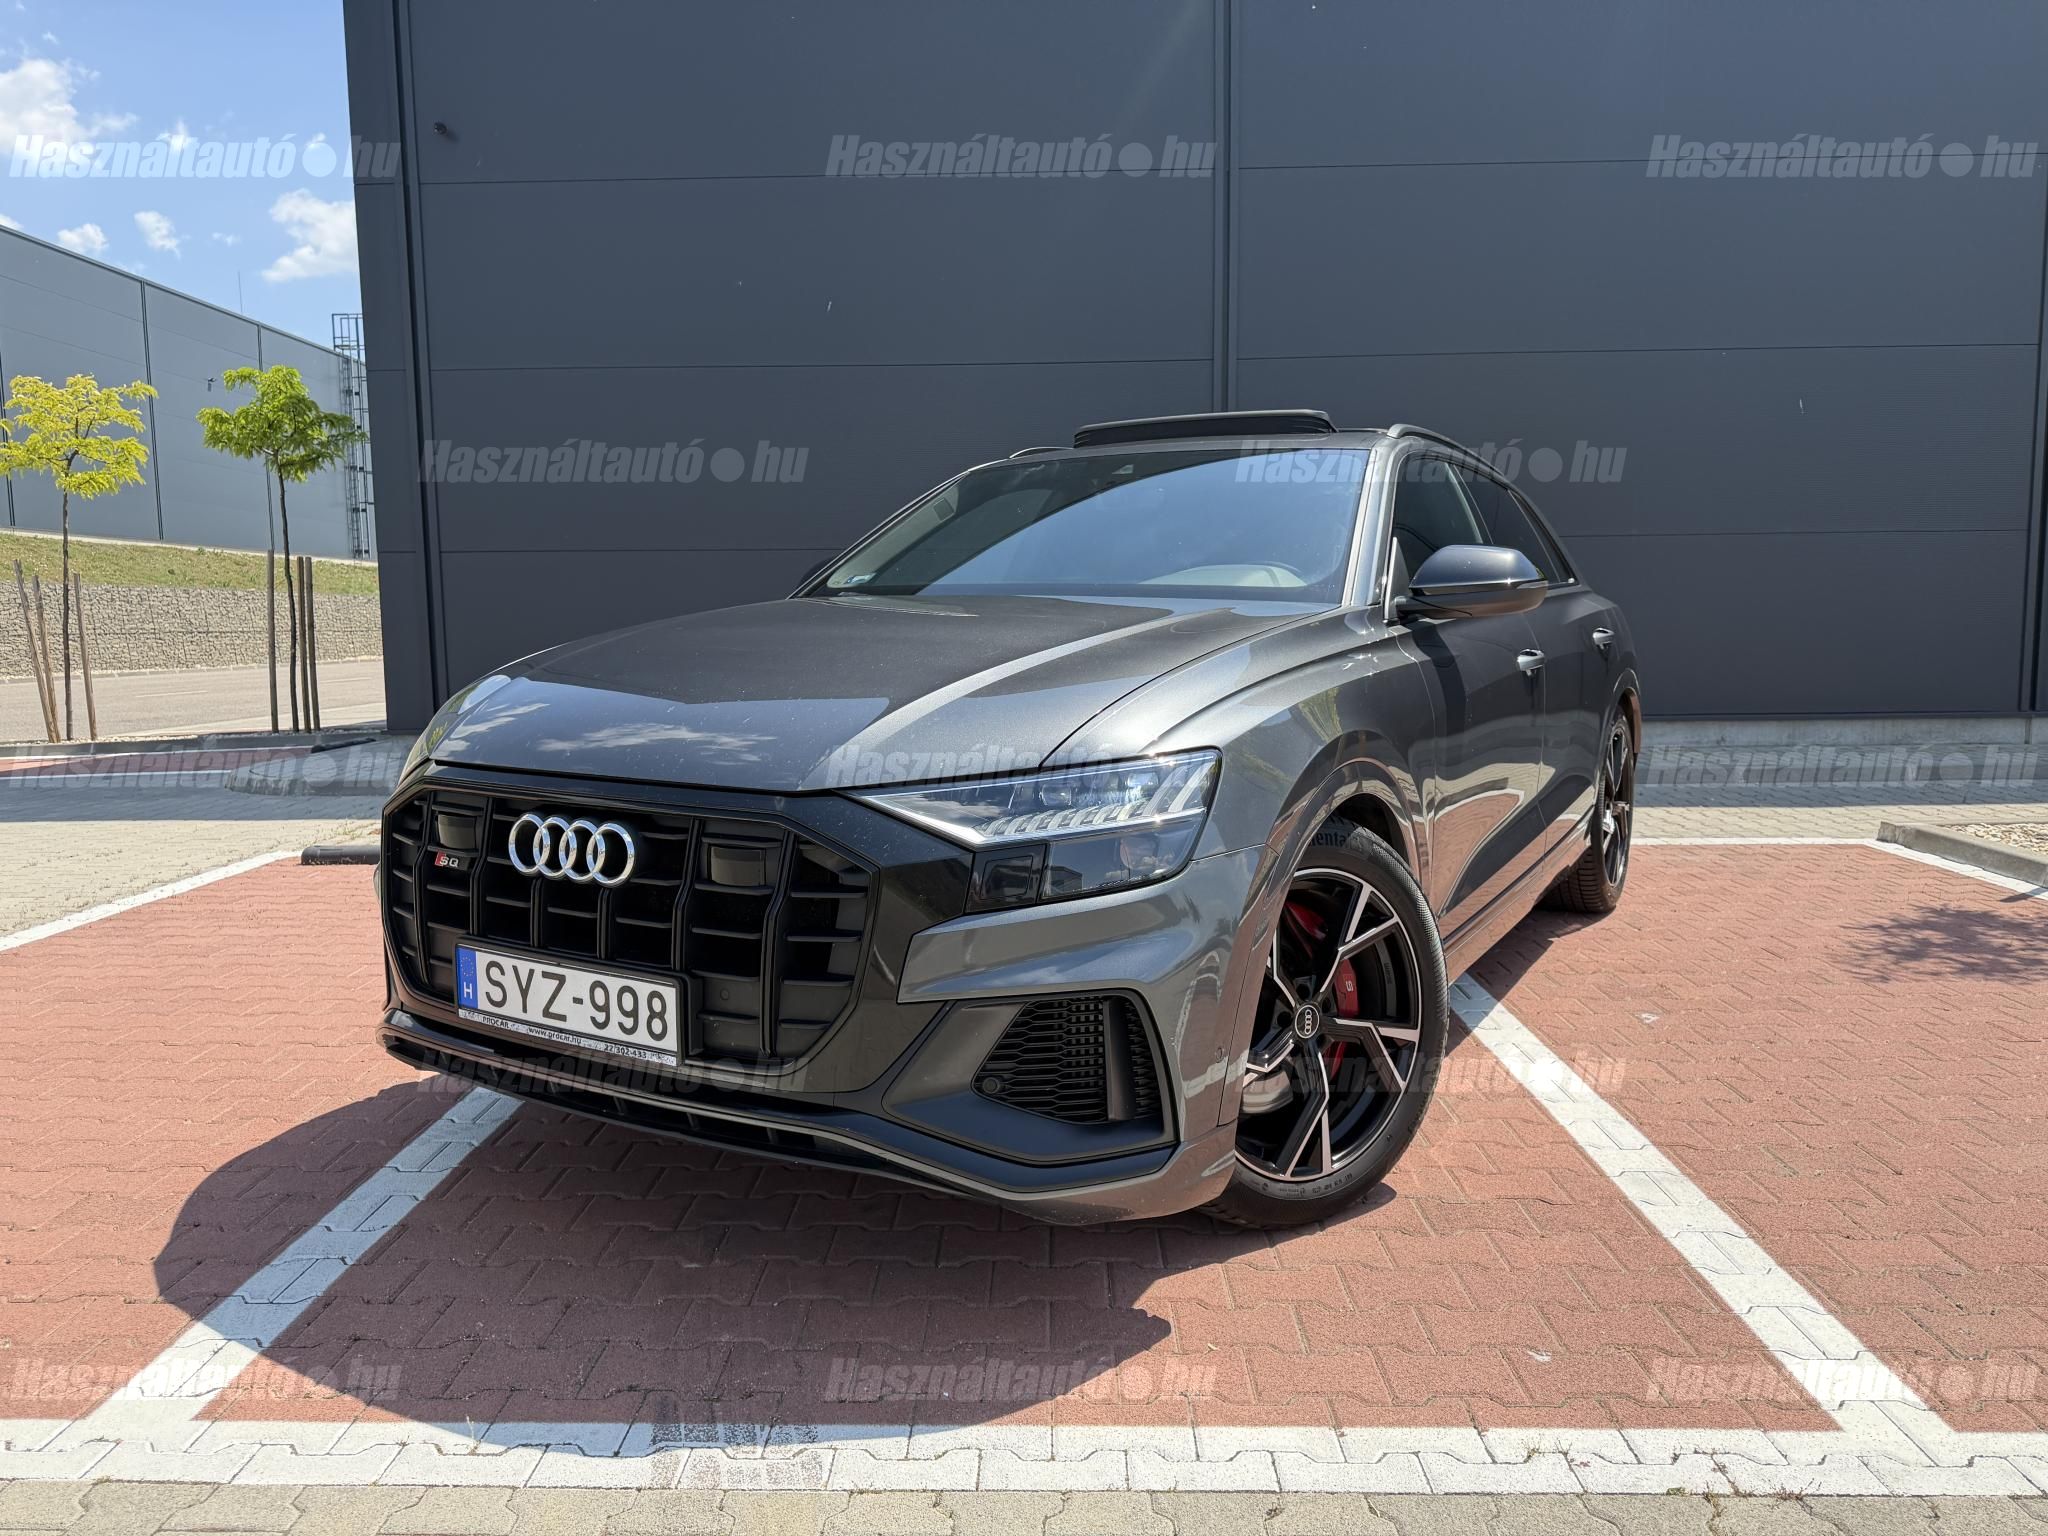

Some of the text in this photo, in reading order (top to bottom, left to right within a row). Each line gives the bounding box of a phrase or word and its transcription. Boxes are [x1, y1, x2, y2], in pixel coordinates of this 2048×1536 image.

[463, 982, 473, 999] H
[485, 960, 668, 1042] SYZ-998
[482, 1016, 510, 1029] PROCAR
